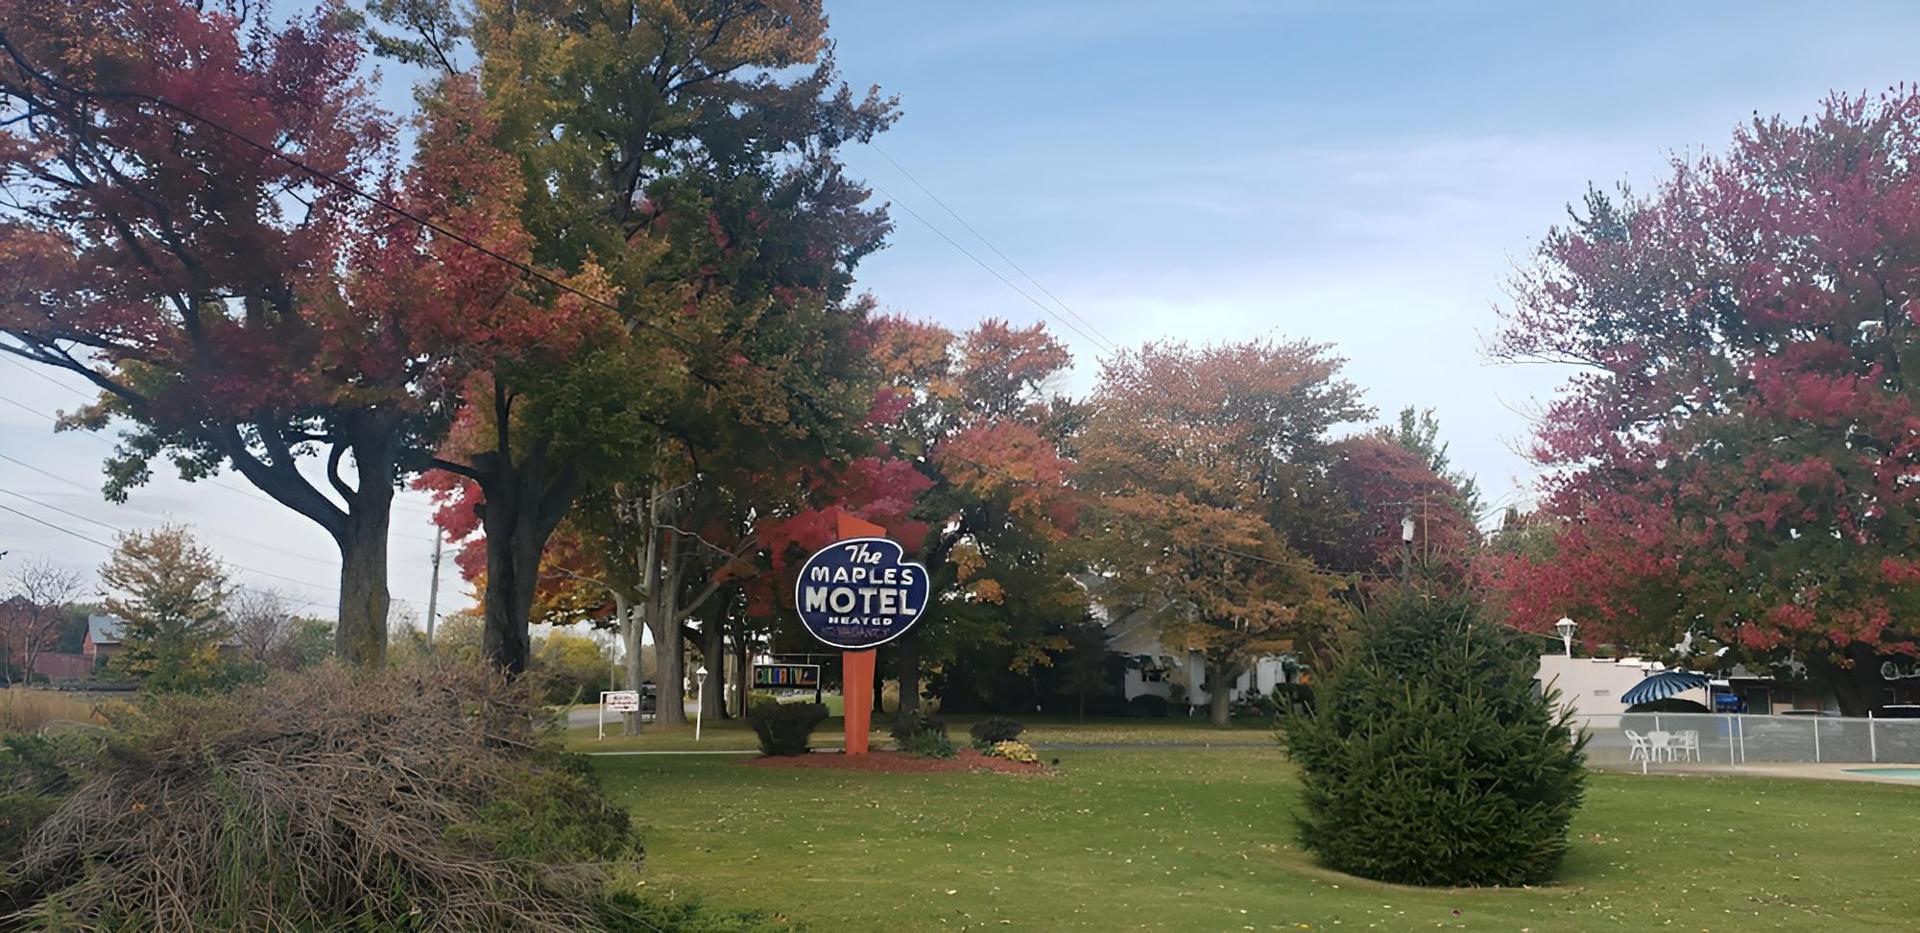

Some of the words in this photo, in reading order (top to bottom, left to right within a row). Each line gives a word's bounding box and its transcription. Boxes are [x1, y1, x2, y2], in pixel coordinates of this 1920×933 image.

[845, 543, 883, 564] The
[811, 566, 914, 585] MAPLES
[805, 586, 917, 615] MOTEL
